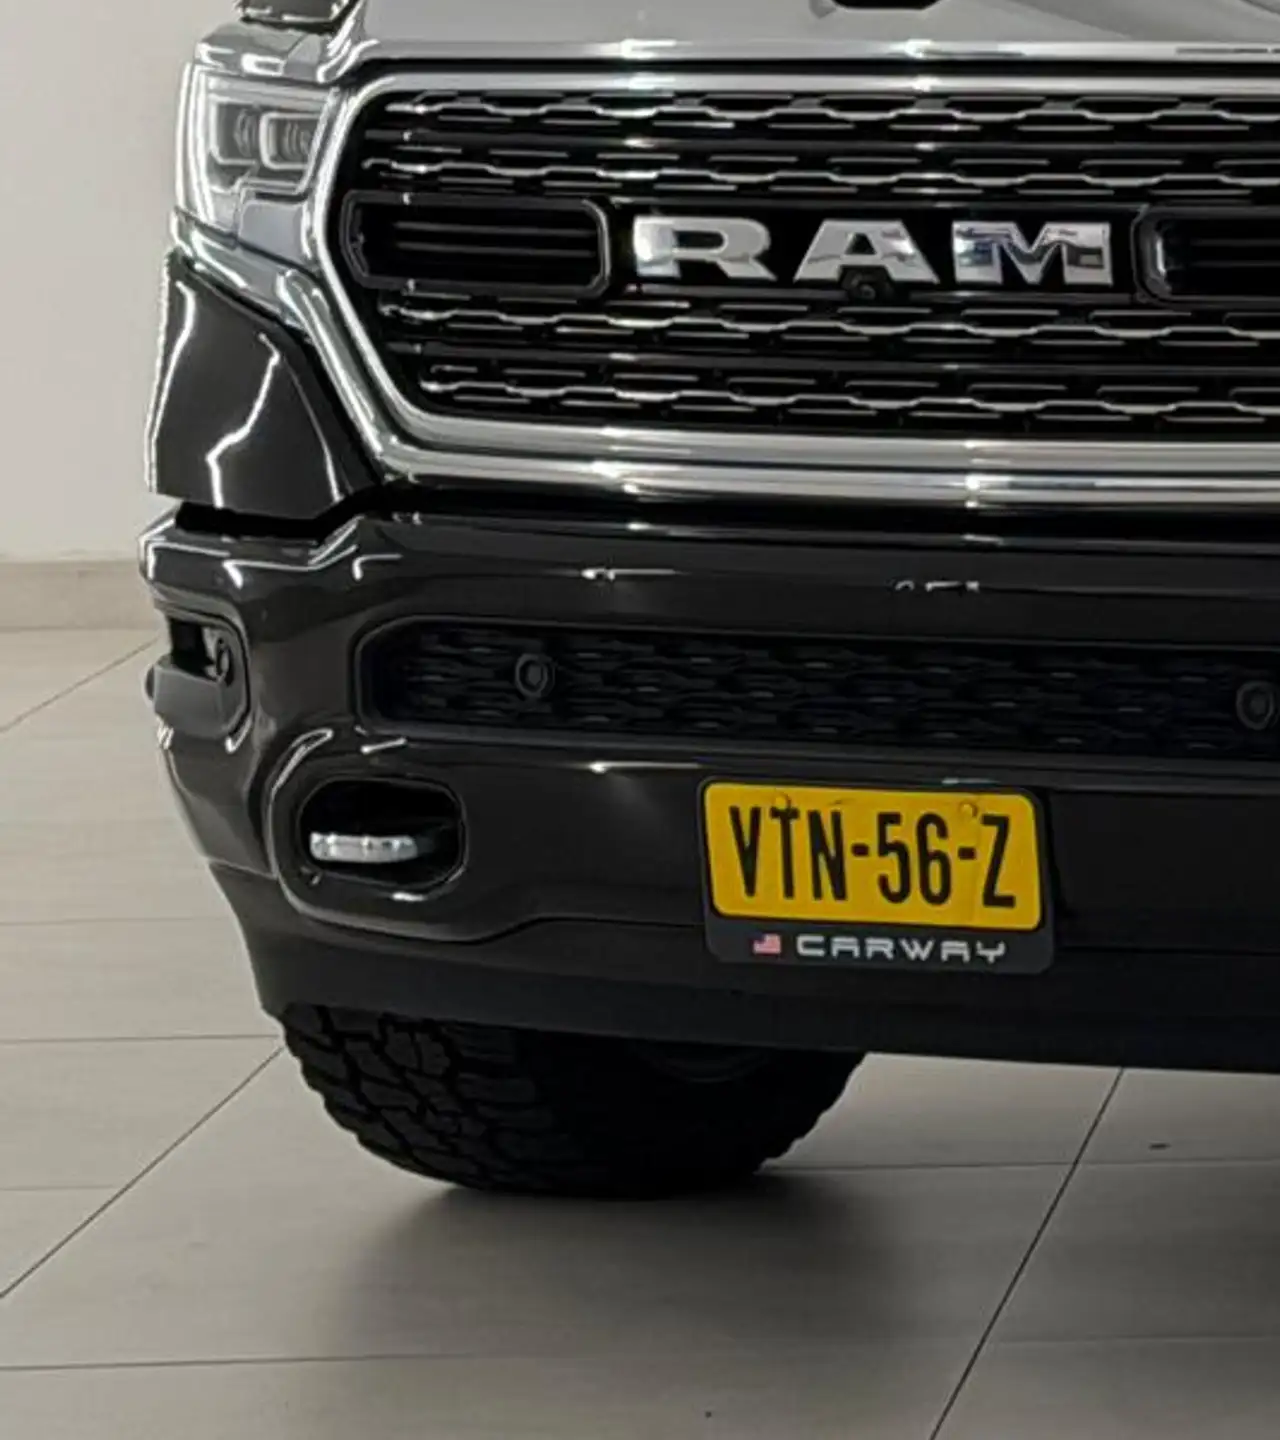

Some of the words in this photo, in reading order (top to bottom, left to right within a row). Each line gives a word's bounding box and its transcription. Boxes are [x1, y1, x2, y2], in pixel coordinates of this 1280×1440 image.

[632, 215, 1113, 285] RAM
[729, 805, 1017, 909] VTN-56-Z
[796, 934, 1006, 963] CARWAY
